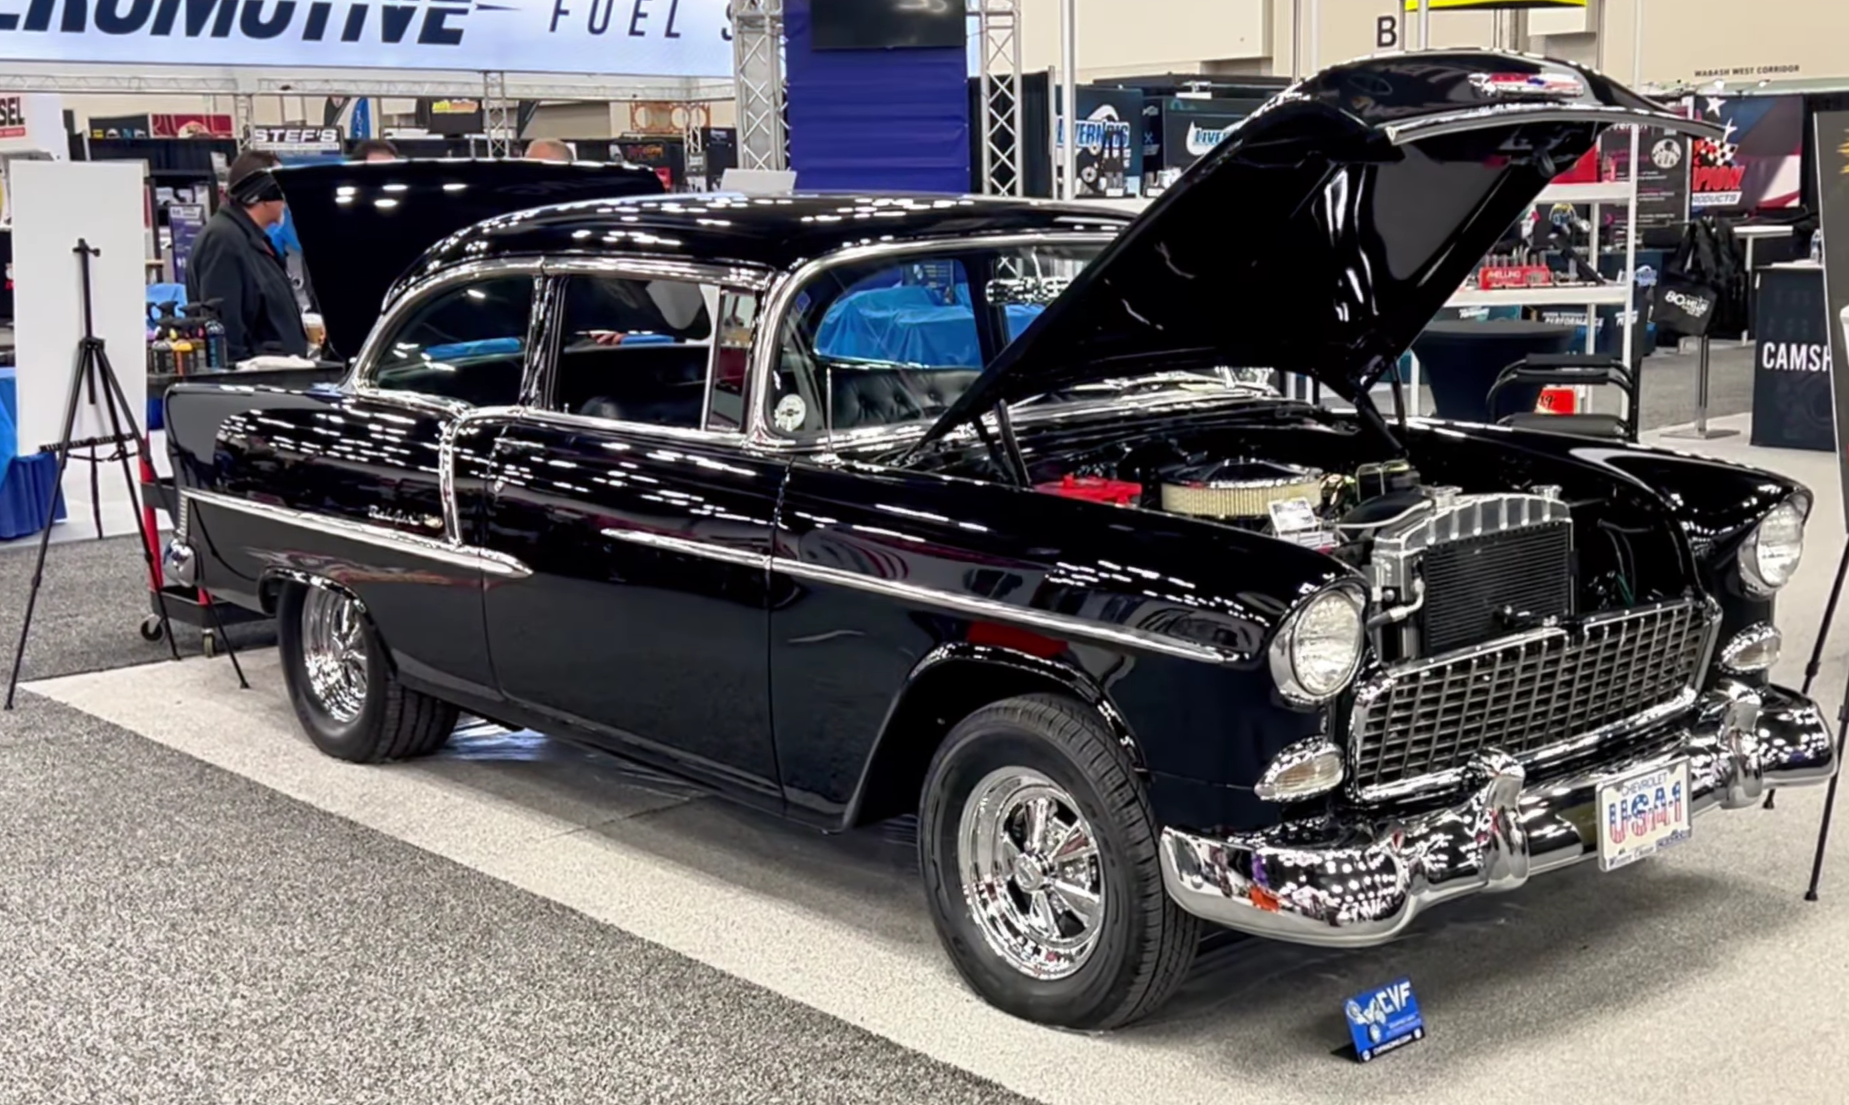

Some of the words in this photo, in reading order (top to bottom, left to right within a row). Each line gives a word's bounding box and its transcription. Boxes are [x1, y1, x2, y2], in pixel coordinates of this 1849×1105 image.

[549, 0, 681, 38] FUEL
[1377, 15, 1397, 47] B
[1694, 69, 1730, 77] WABASH
[1732, 67, 1754, 75] WEST
[1757, 65, 1799, 74] CORRIDOR
[255, 128, 338, 142] STEF'S
[1621, 772, 1667, 797] CHEVROLET
[1376, 981, 1411, 1014] CVF
